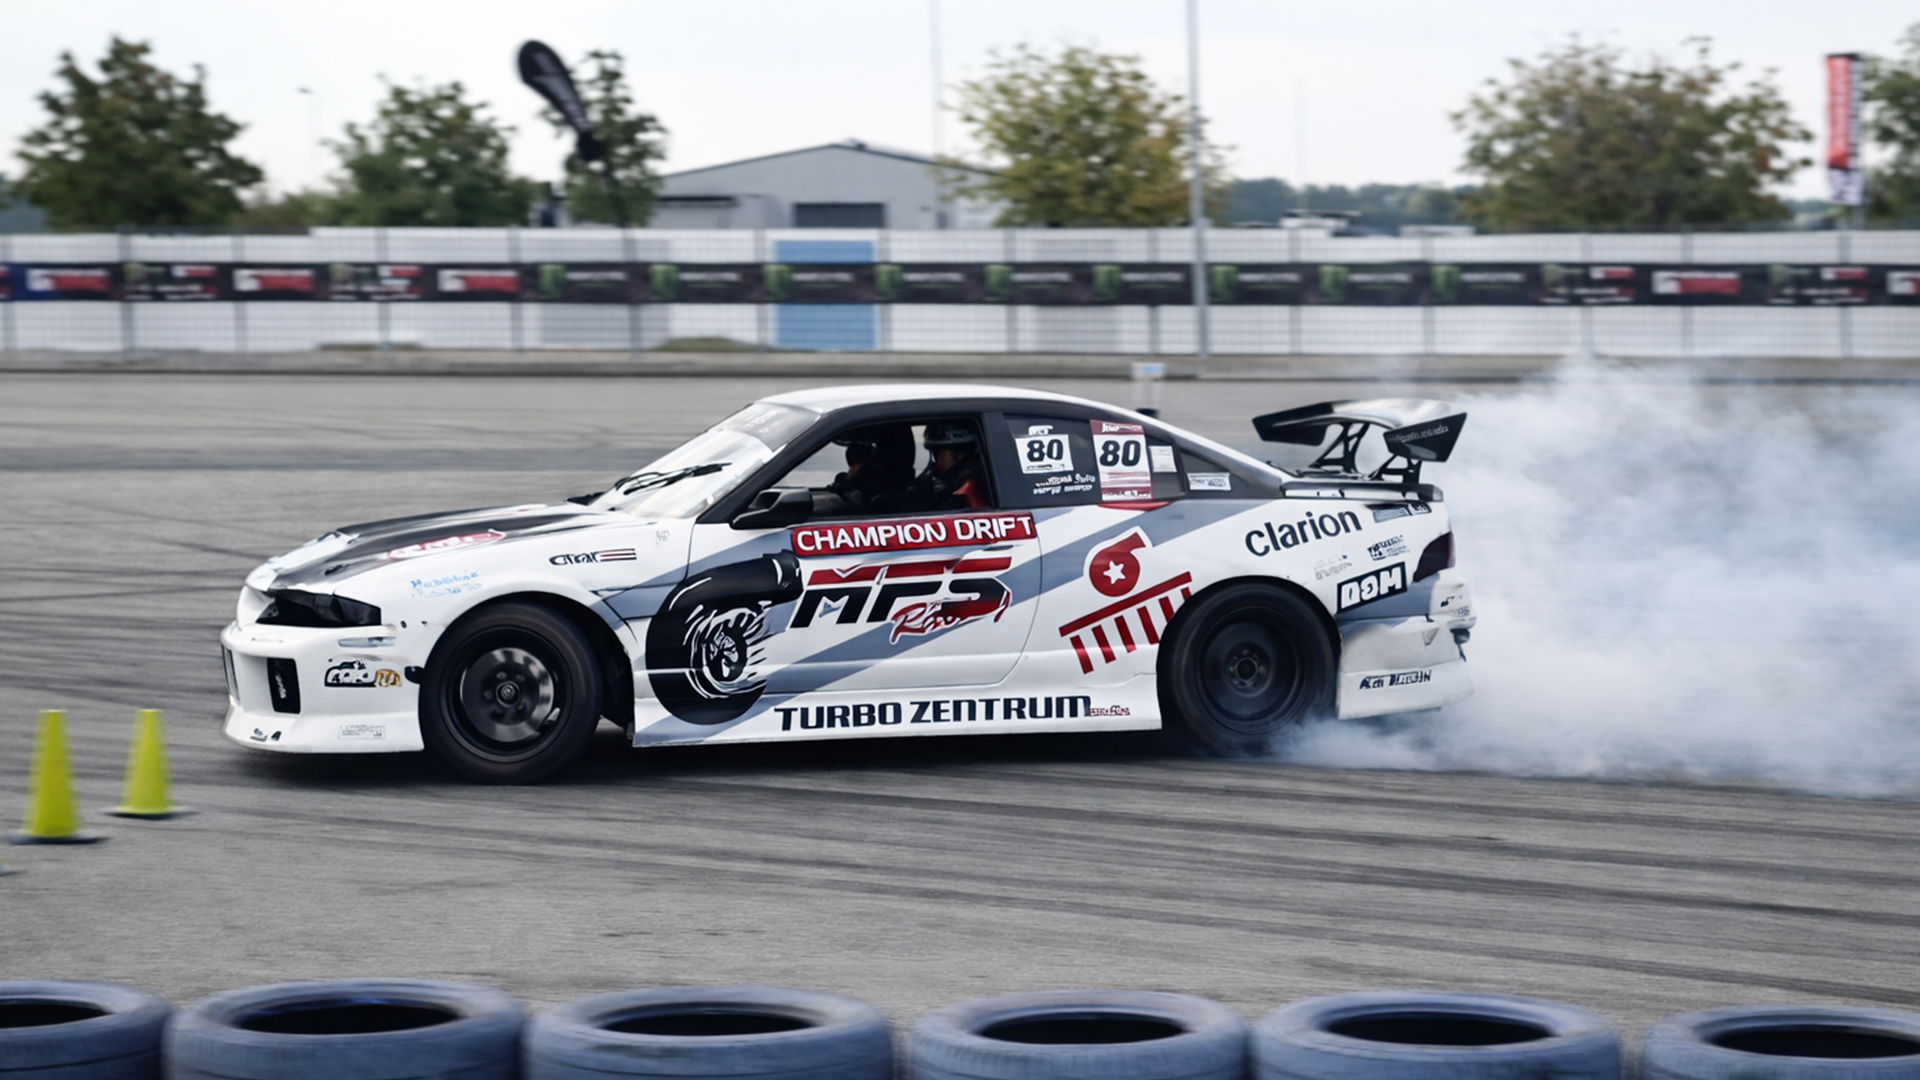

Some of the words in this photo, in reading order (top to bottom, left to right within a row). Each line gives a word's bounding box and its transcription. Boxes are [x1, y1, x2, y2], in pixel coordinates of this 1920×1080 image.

[1027, 439, 1064, 462] 80
[1099, 440, 1141, 467] 80
[796, 521, 947, 551] CHAMPION
[953, 516, 1032, 541] DRIFT
[790, 556, 1012, 629] MFS
[774, 702, 902, 731] TURBO
[910, 695, 1092, 724] ZENTRUM
